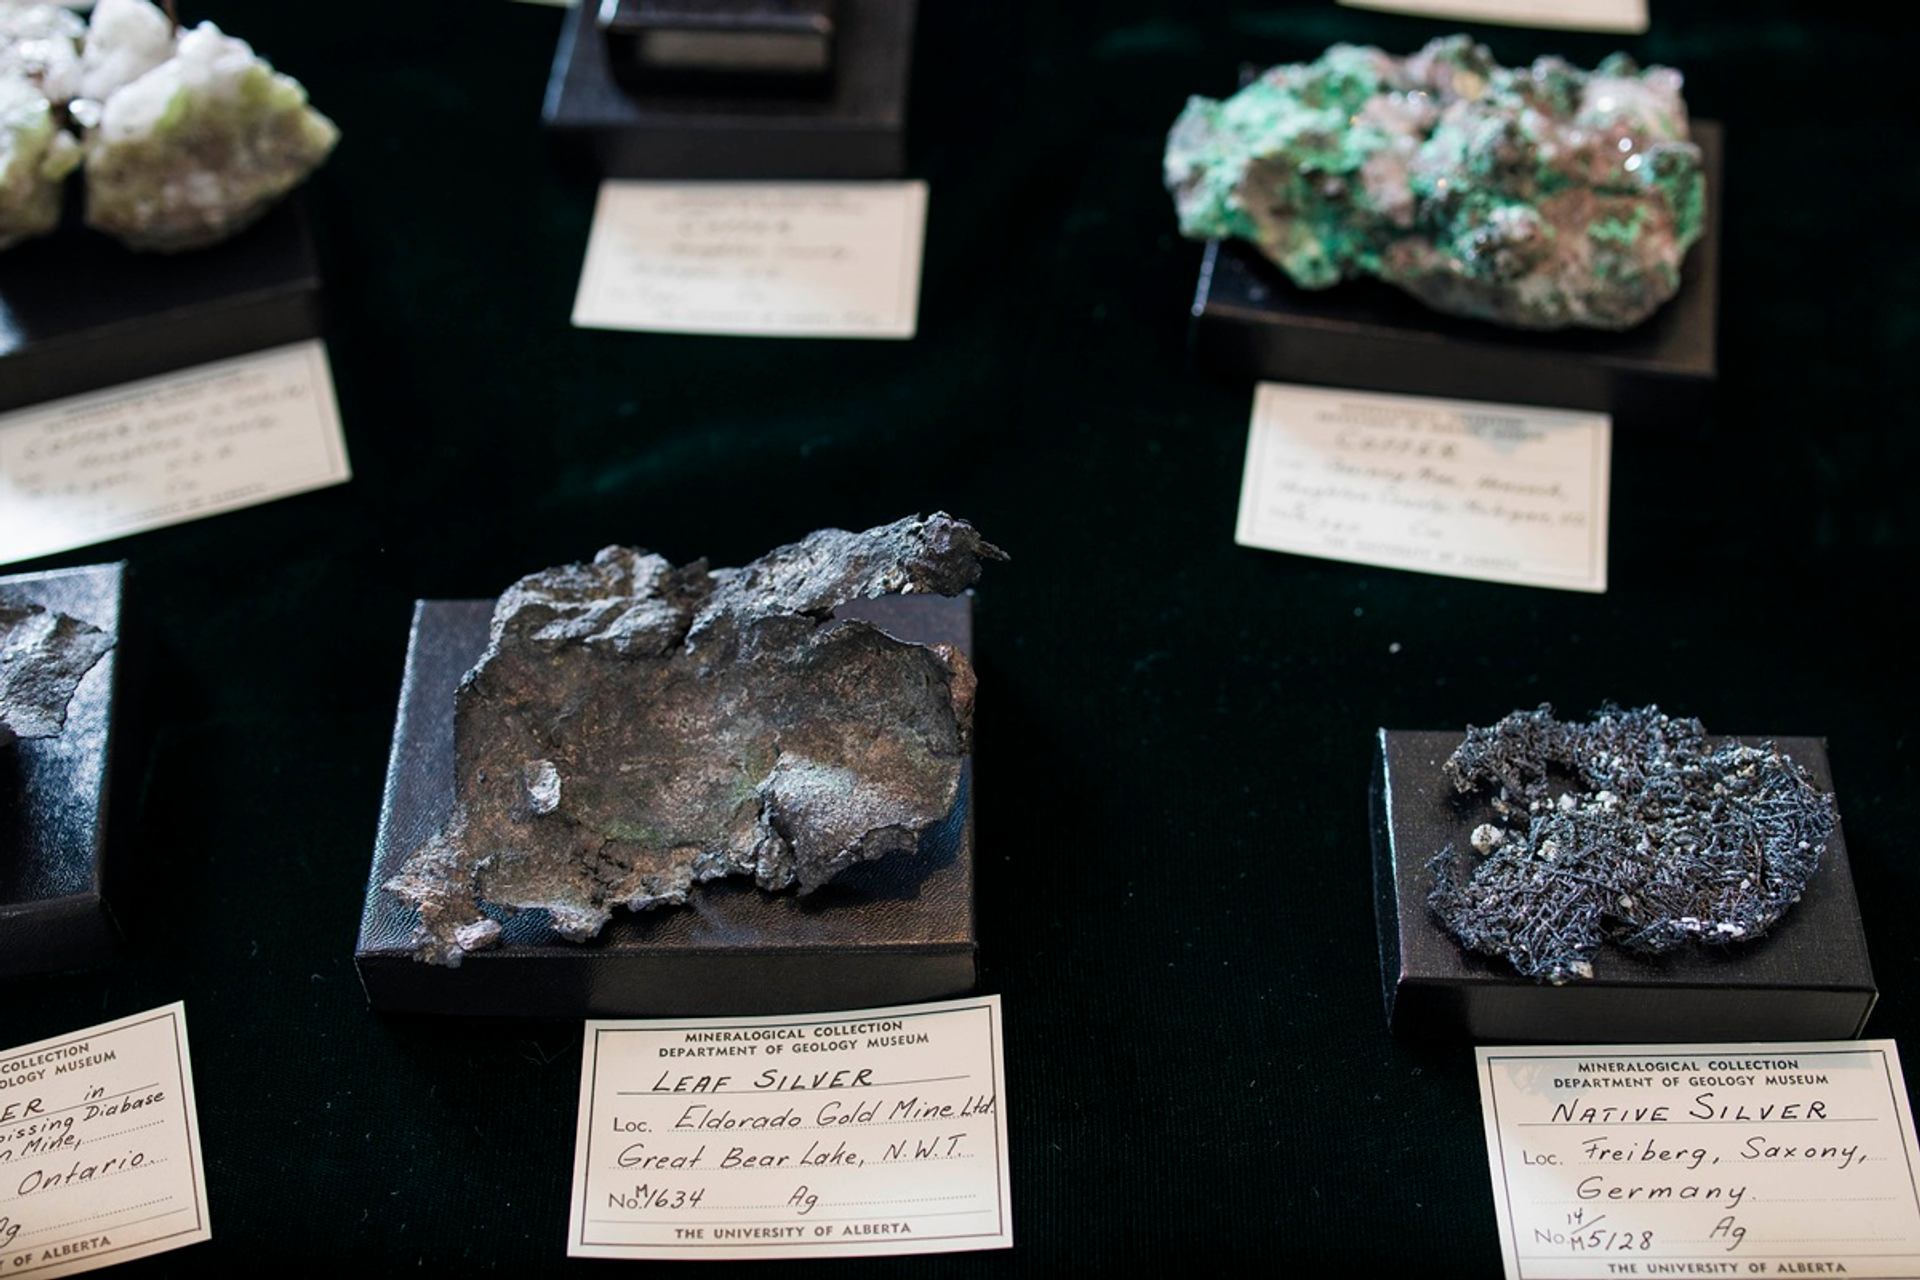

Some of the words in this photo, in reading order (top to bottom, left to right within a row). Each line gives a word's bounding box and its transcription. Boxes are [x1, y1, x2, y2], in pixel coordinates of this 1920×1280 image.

[685, 1028, 806, 1043] MINERALOGICAL
[814, 1020, 904, 1038] COLLECTION
[1, 1042, 89, 1074] COLLECTION
[659, 1045, 757, 1058] DEPARTMENT
[766, 1044, 784, 1055] OF
[792, 1039, 858, 1053] GEOLOGY
[867, 1033, 929, 1049] MUSEUM
[0, 1069, 46, 1090] OLOGY
[55, 1050, 116, 1075] MUSEUM
[1578, 1062, 1700, 1072] MINERALOGICAL
[1708, 1060, 1799, 1070] COLLECTION
[83, 1084, 105, 1101] in
[651, 1071, 732, 1093] LEAF
[754, 1068, 874, 1091] SILVER
[1554, 1076, 1654, 1088] DEPARTMENT
[1662, 1077, 1680, 1087] OF
[1689, 1076, 1755, 1086] GEOLOGY
[1765, 1075, 1829, 1085] MUSEUM
[83, 1091, 165, 1122] Diabase
[613, 1117, 653, 1133] Loc.
[675, 1104, 801, 1130] Eldorado
[816, 1100, 880, 1126] Gold
[888, 1097, 954, 1120] Mine
[1551, 1099, 1670, 1123] NATIVE
[1689, 1093, 1828, 1121] SILVER
[617, 1143, 706, 1168] Great
[720, 1147, 790, 1167] Bear
[799, 1141, 865, 1168] Lake,
[1523, 1151, 1563, 1166] Loc.
[1581, 1137, 1719, 1169] Freiberg,
[1740, 1137, 1867, 1169] Saxony,
[787, 1186, 819, 1214] Ag
[676, 1229, 704, 1239] THE
[714, 1226, 805, 1239] UNIVERSITY
[815, 1226, 833, 1236] OF
[842, 1223, 912, 1236] ALBERTA
[1709, 1216, 1746, 1251] Ag
[13, 1253, 33, 1267] OF
[42, 1236, 111, 1260] ALBERTA
[1608, 1264, 1636, 1273] THE
[1647, 1263, 1739, 1274] UNIVERSITY
[1749, 1263, 1767, 1274] OF
[1778, 1263, 1847, 1274] ALBERTA
